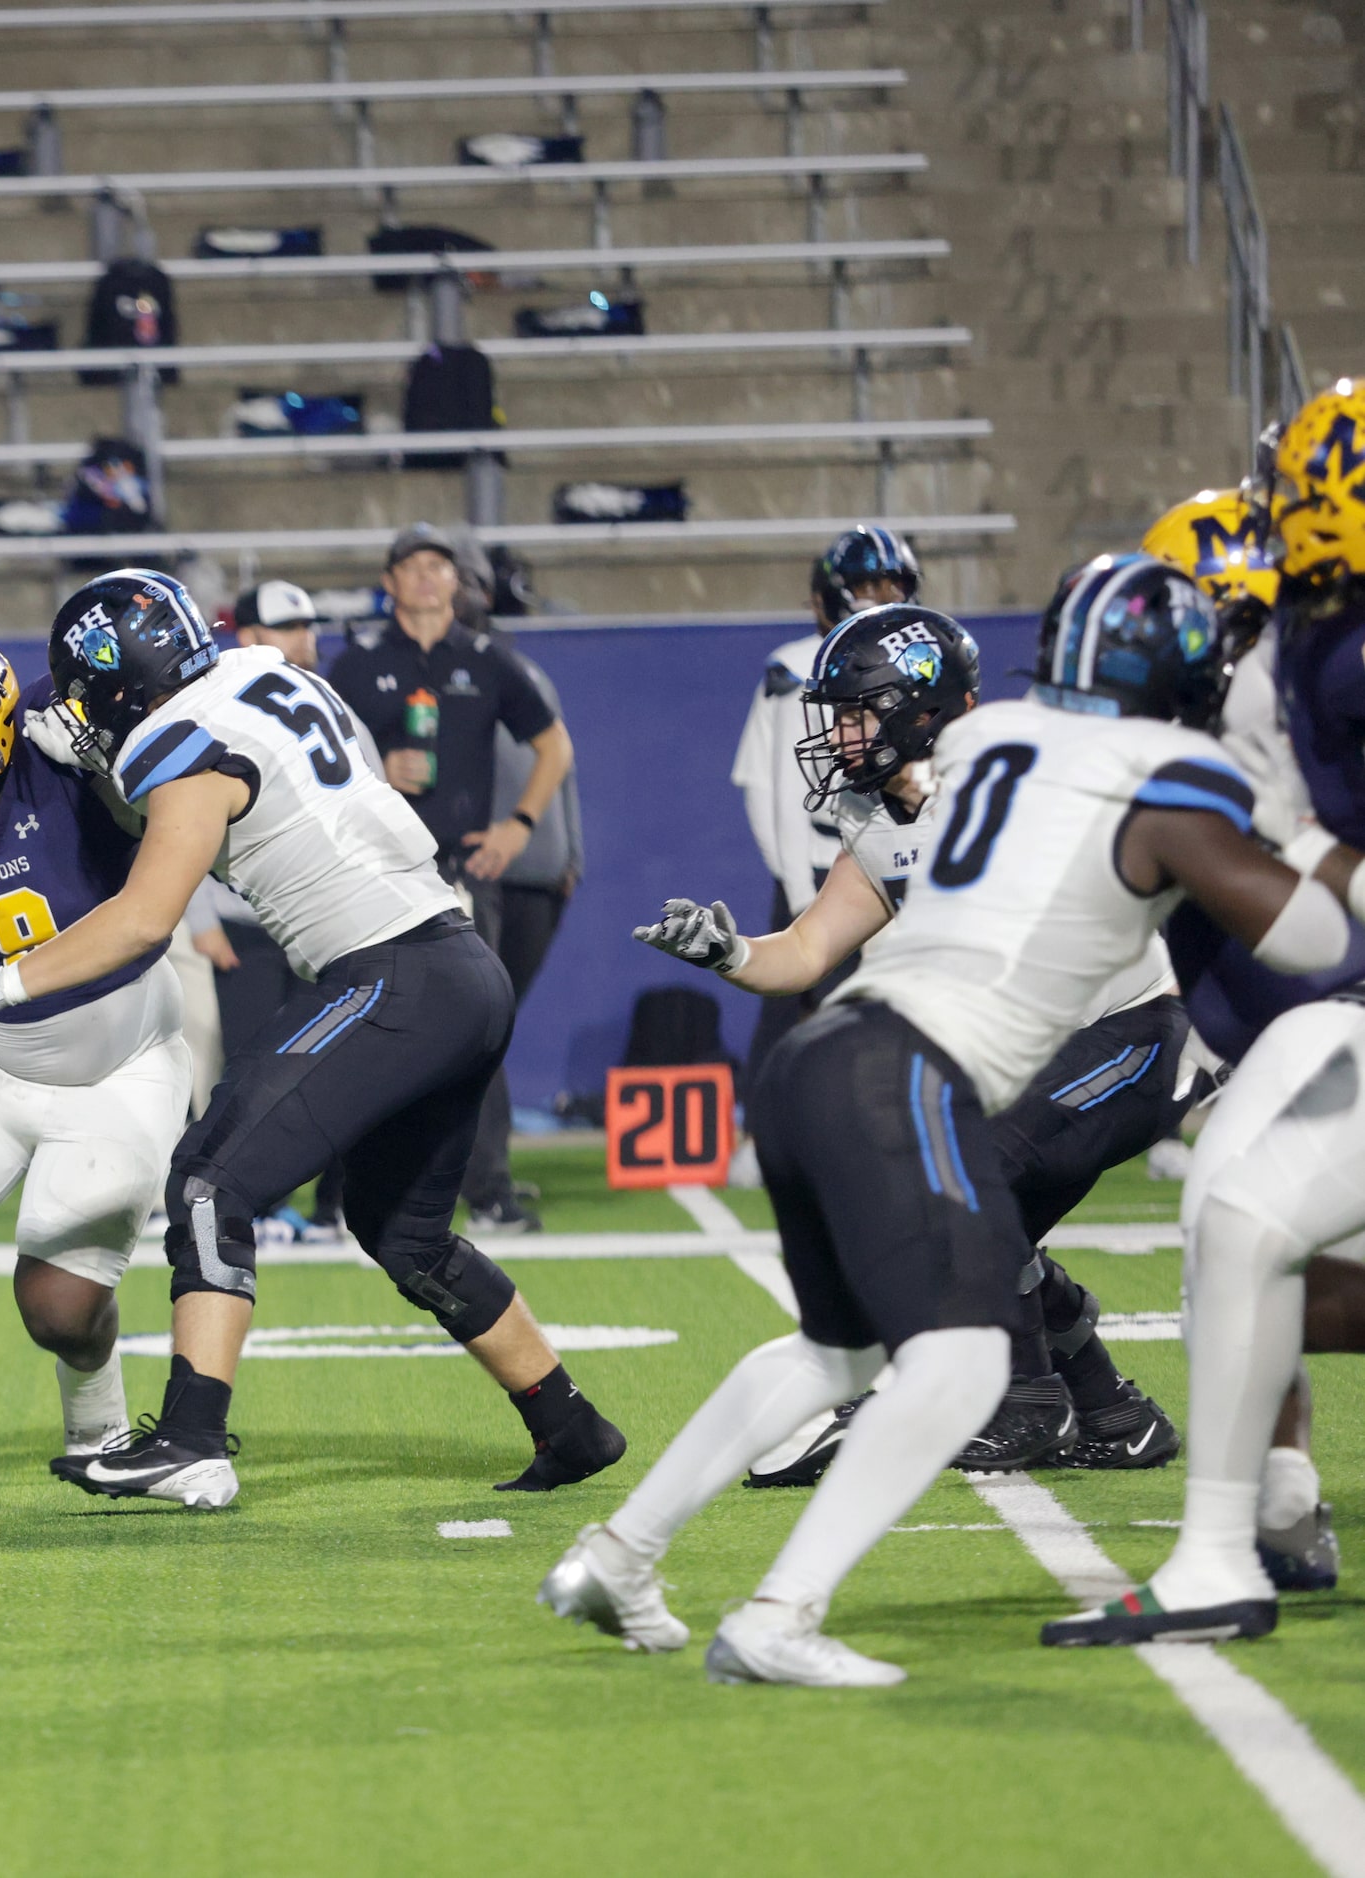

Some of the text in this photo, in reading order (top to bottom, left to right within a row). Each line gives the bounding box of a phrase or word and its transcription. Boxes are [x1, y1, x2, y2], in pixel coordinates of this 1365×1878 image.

[1190, 515, 1274, 578] M
[63, 601, 113, 658] RH
[877, 621, 939, 664] RH
[928, 740, 1040, 892] 0
[619, 1081, 718, 1168] 20
